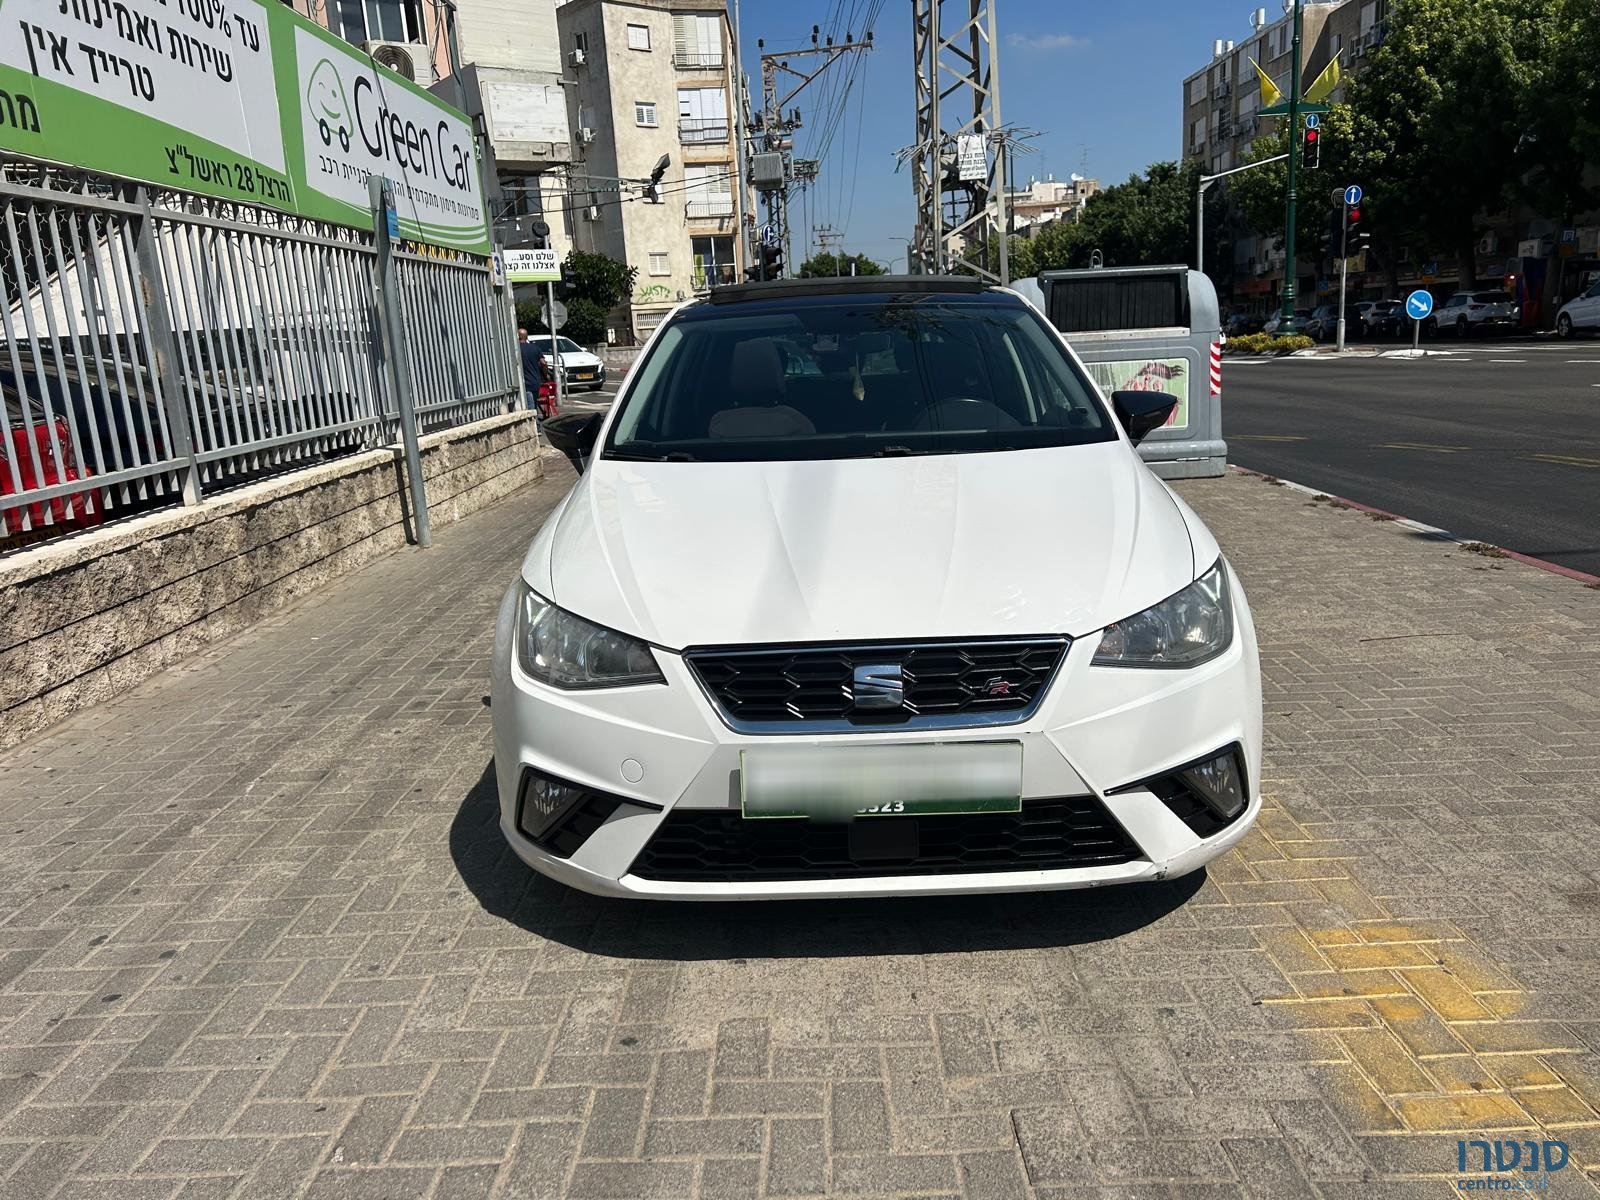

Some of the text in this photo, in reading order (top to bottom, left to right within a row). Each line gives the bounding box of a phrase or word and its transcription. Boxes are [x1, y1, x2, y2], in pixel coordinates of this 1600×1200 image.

[234, 13, 260, 52] עד
[19, 20, 155, 102] טרייד אין
[166, 26, 233, 83] שירות
[354, 75, 471, 192] Green Car
[234, 163, 255, 193] 28
[319, 154, 340, 177] רכב
[255, 167, 291, 202] הרצל
[521, 262, 531, 270] זה
[533, 261, 556, 270] אצלנו
[536, 252, 554, 261] שלם
